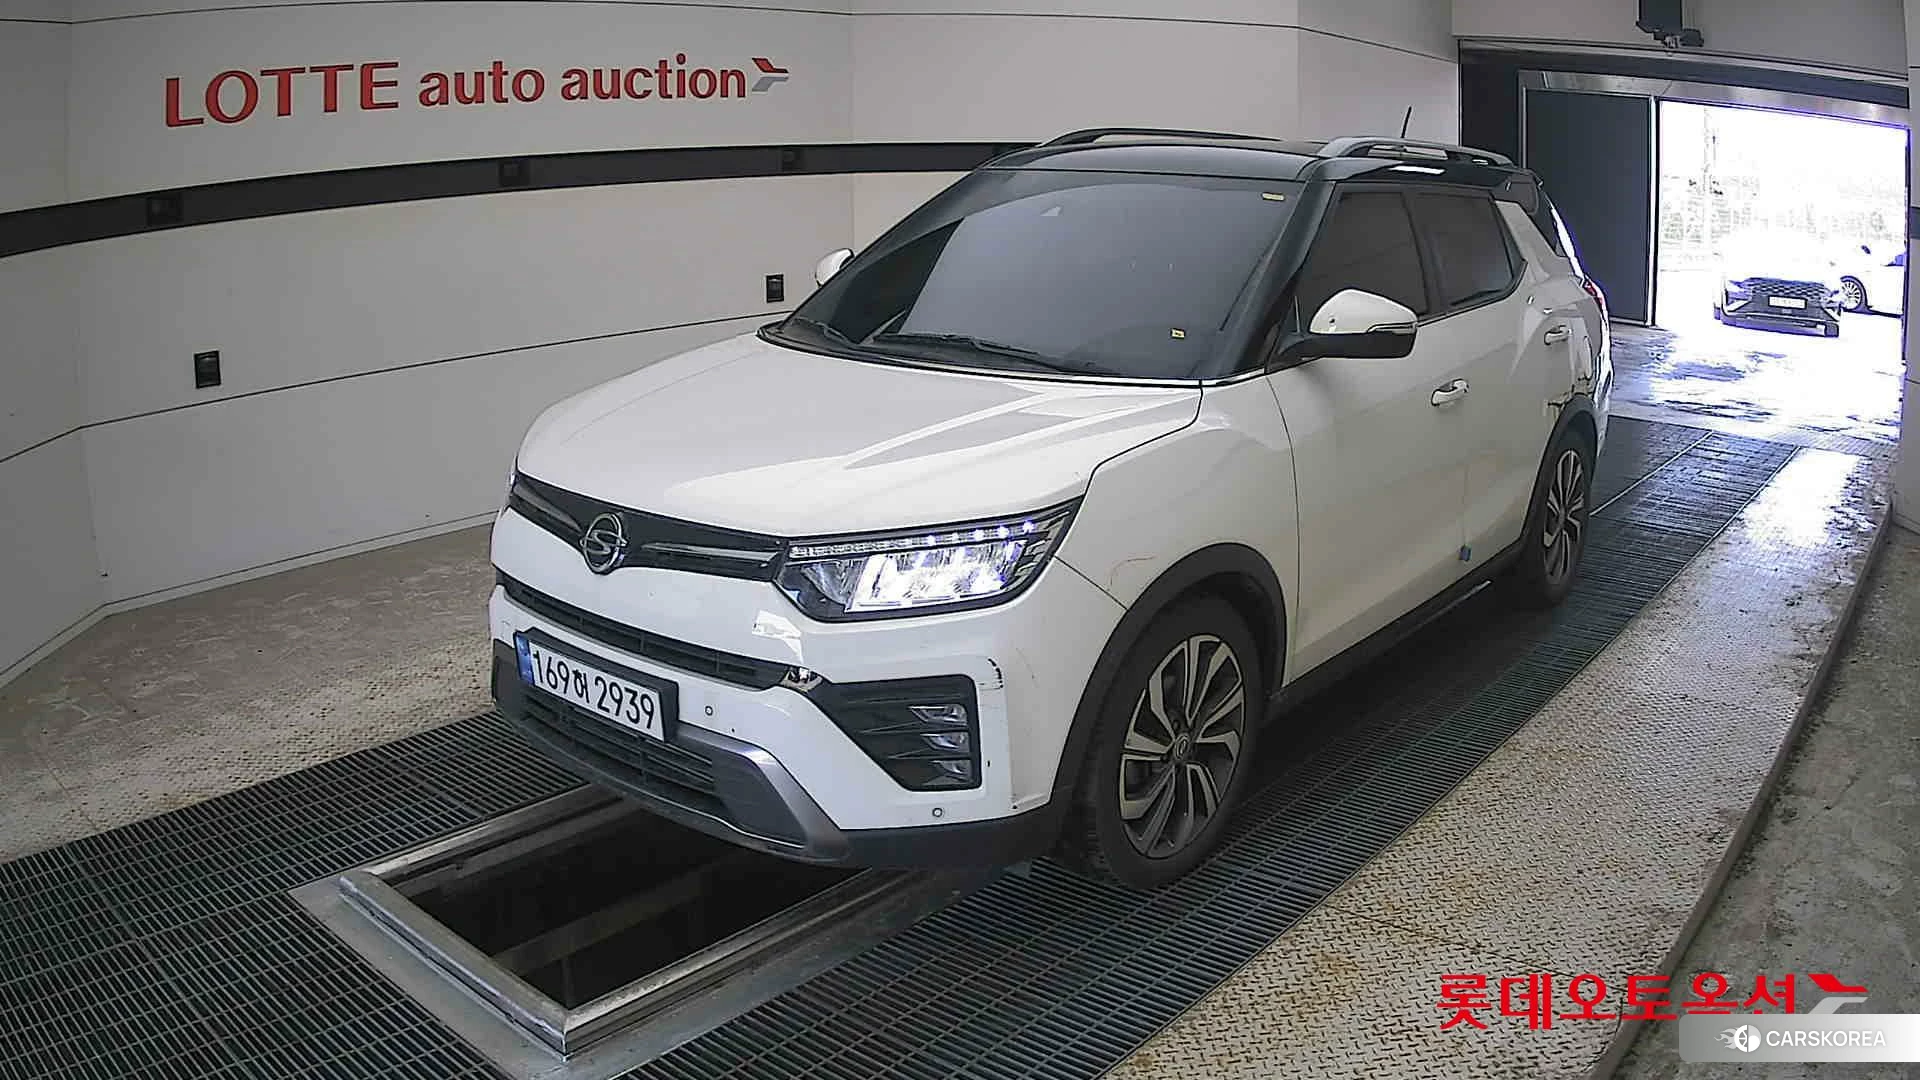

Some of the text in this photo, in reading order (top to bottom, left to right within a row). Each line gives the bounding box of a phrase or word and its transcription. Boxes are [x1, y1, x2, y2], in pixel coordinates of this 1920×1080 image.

[165, 54, 746, 127] LOTTE auto auction
[594, 675, 655, 730] 2939
